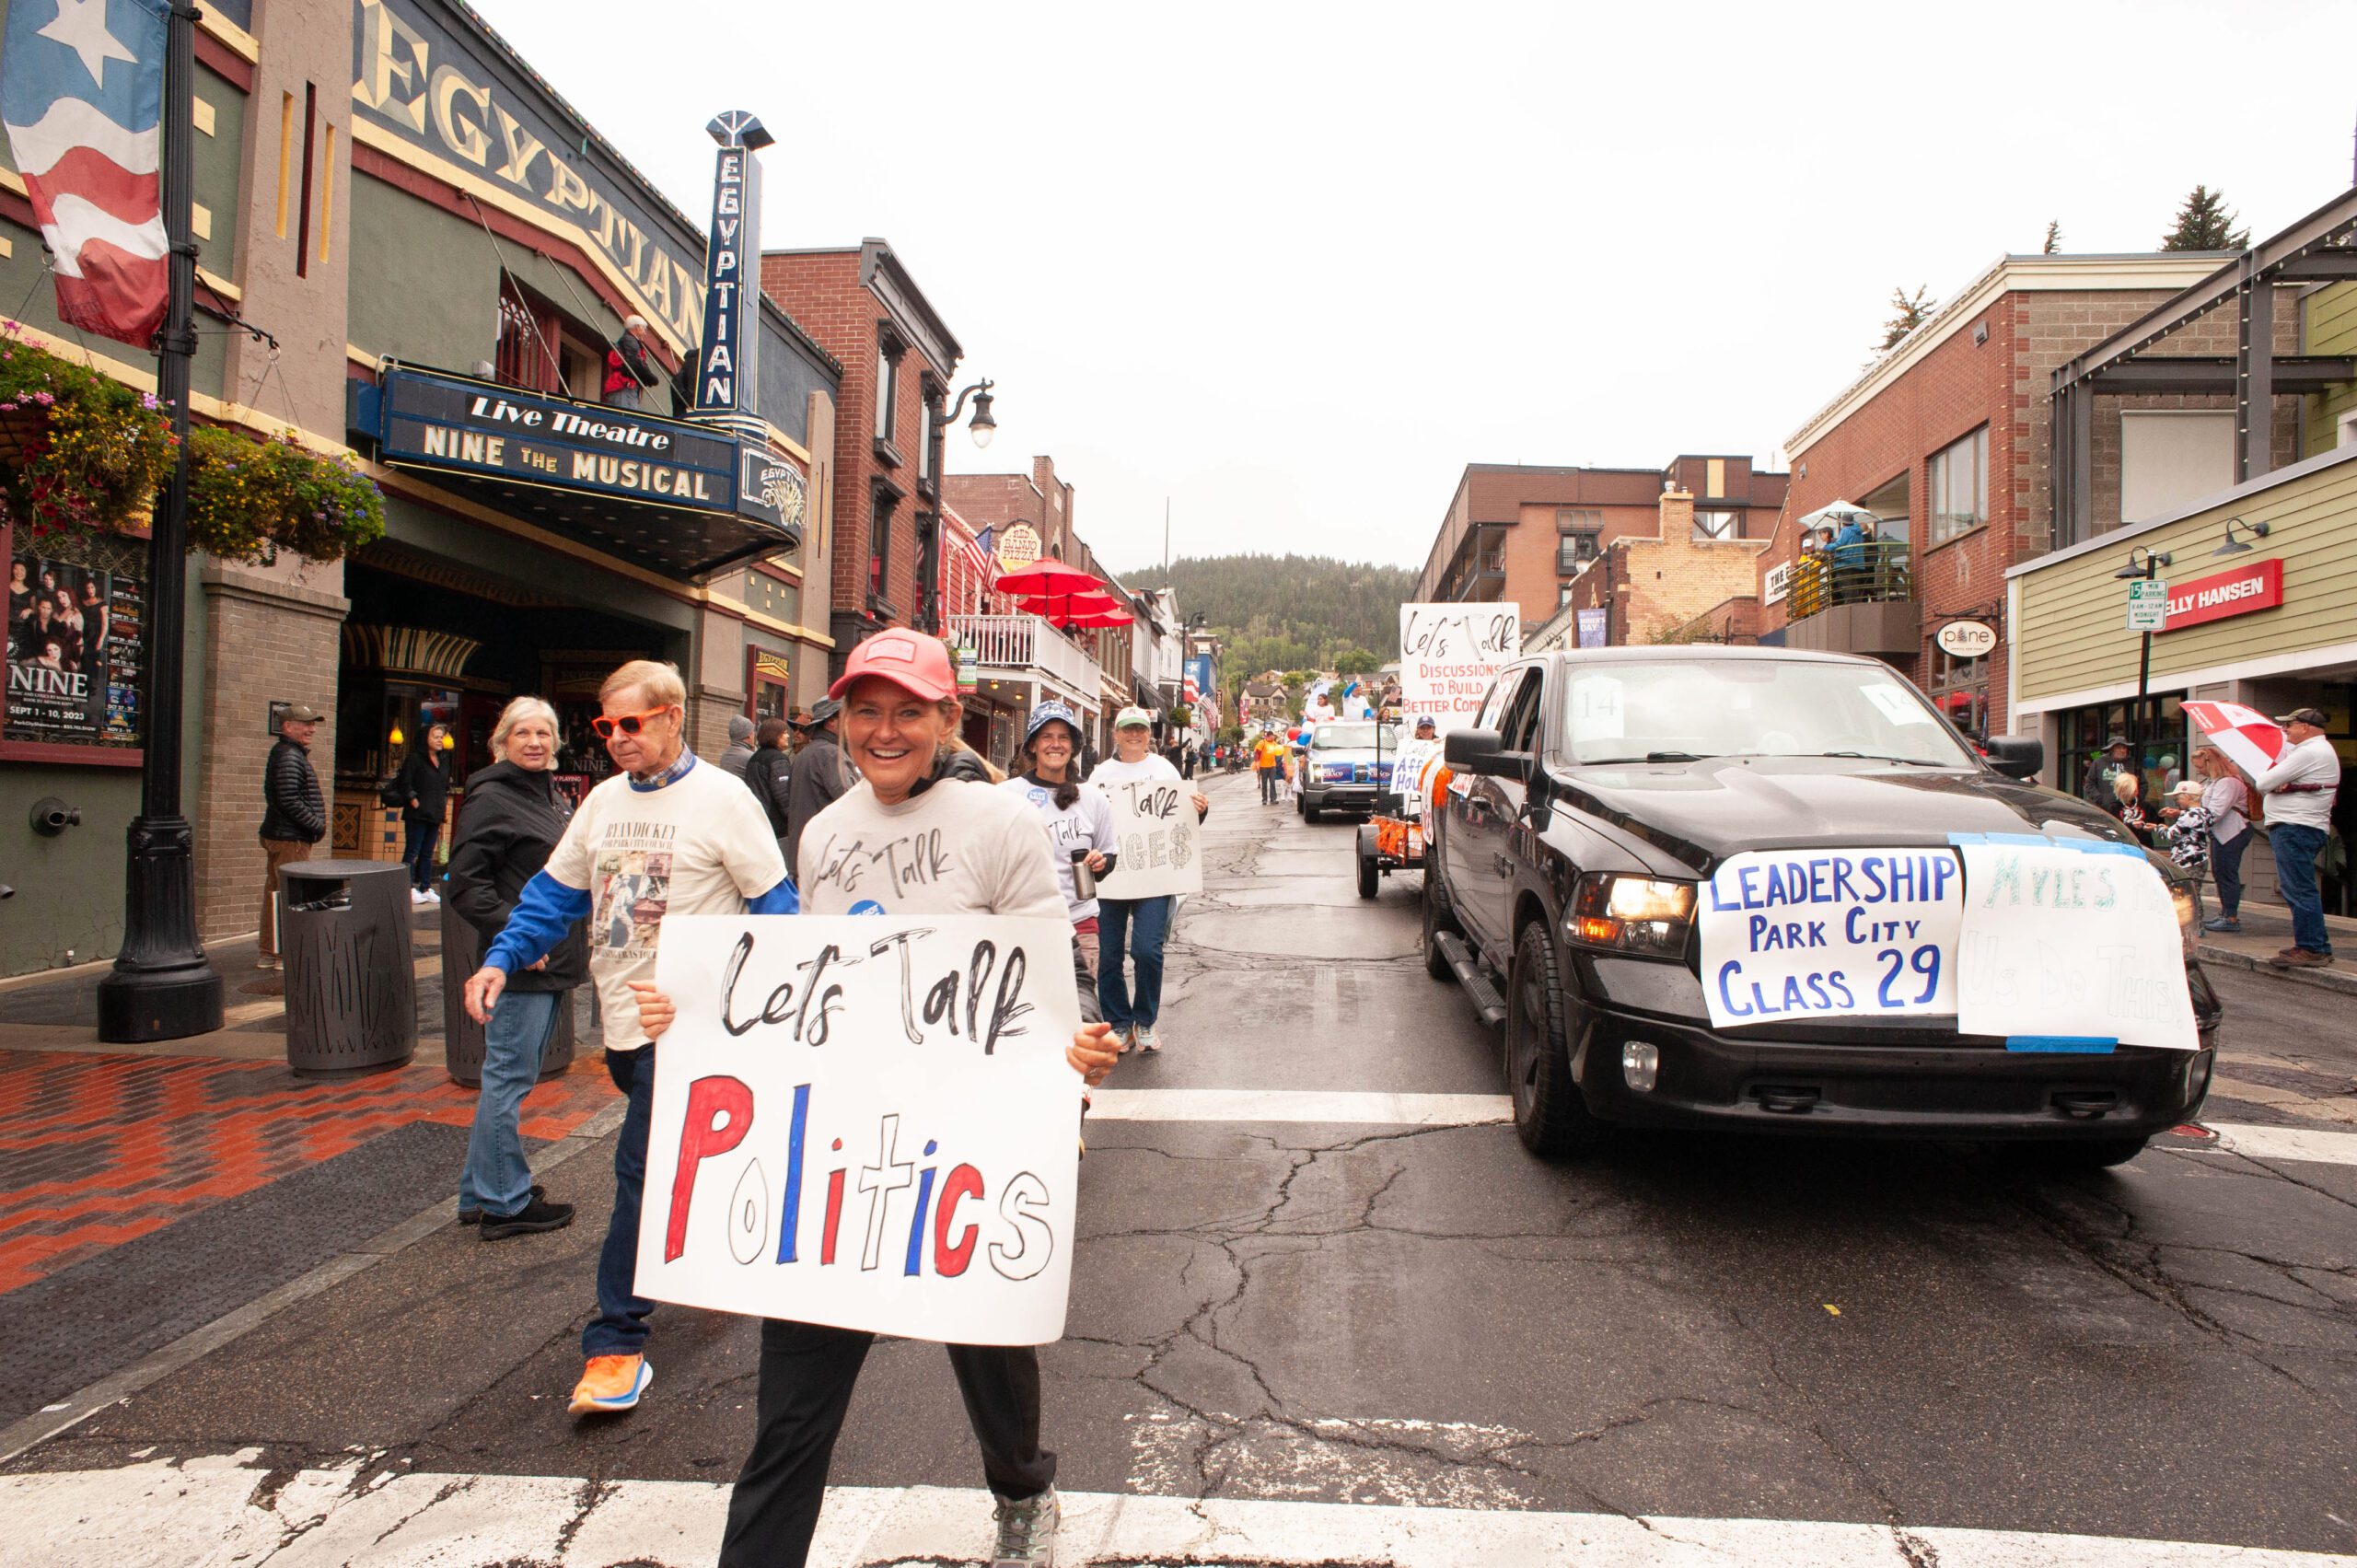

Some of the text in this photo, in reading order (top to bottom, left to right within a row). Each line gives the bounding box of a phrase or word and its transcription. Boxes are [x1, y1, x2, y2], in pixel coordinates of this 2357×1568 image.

[352, 0, 707, 350] EGYPTIAN
[706, 157, 741, 404] EGYPTIAN
[470, 397, 669, 450] Live Theatre
[424, 424, 710, 501] NINE THE MUSICAL
[1004, 539, 1037, 551] BANJO
[1014, 528, 1030, 539] RED
[1003, 550, 1035, 561] PIZZA
[1771, 569, 1784, 587] THE
[2131, 585, 2142, 598] 15
[2165, 576, 2264, 617] ELLY HANSEN
[1451, 612, 1515, 661] Talk
[1580, 624, 1597, 633] DAY
[8, 665, 88, 697] NINE
[9, 705, 32, 715] SEPT
[48, 710, 61, 719] 10,
[63, 711, 85, 720] 2023
[1403, 698, 1450, 713] BETTER
[1583, 691, 1618, 718] 14
[573, 760, 609, 772] NINE
[1121, 781, 1178, 820] Talk
[1048, 816, 1084, 845] Talk
[1115, 822, 1192, 871] AGE$
[872, 828, 955, 899] Talk
[1711, 856, 1956, 912] LEADERSHIP
[1749, 906, 1922, 952] PARK CITY
[870, 926, 1035, 1055] Talk
[1719, 944, 1941, 1016] CLASS 29
[665, 1074, 1054, 1281] Politics
